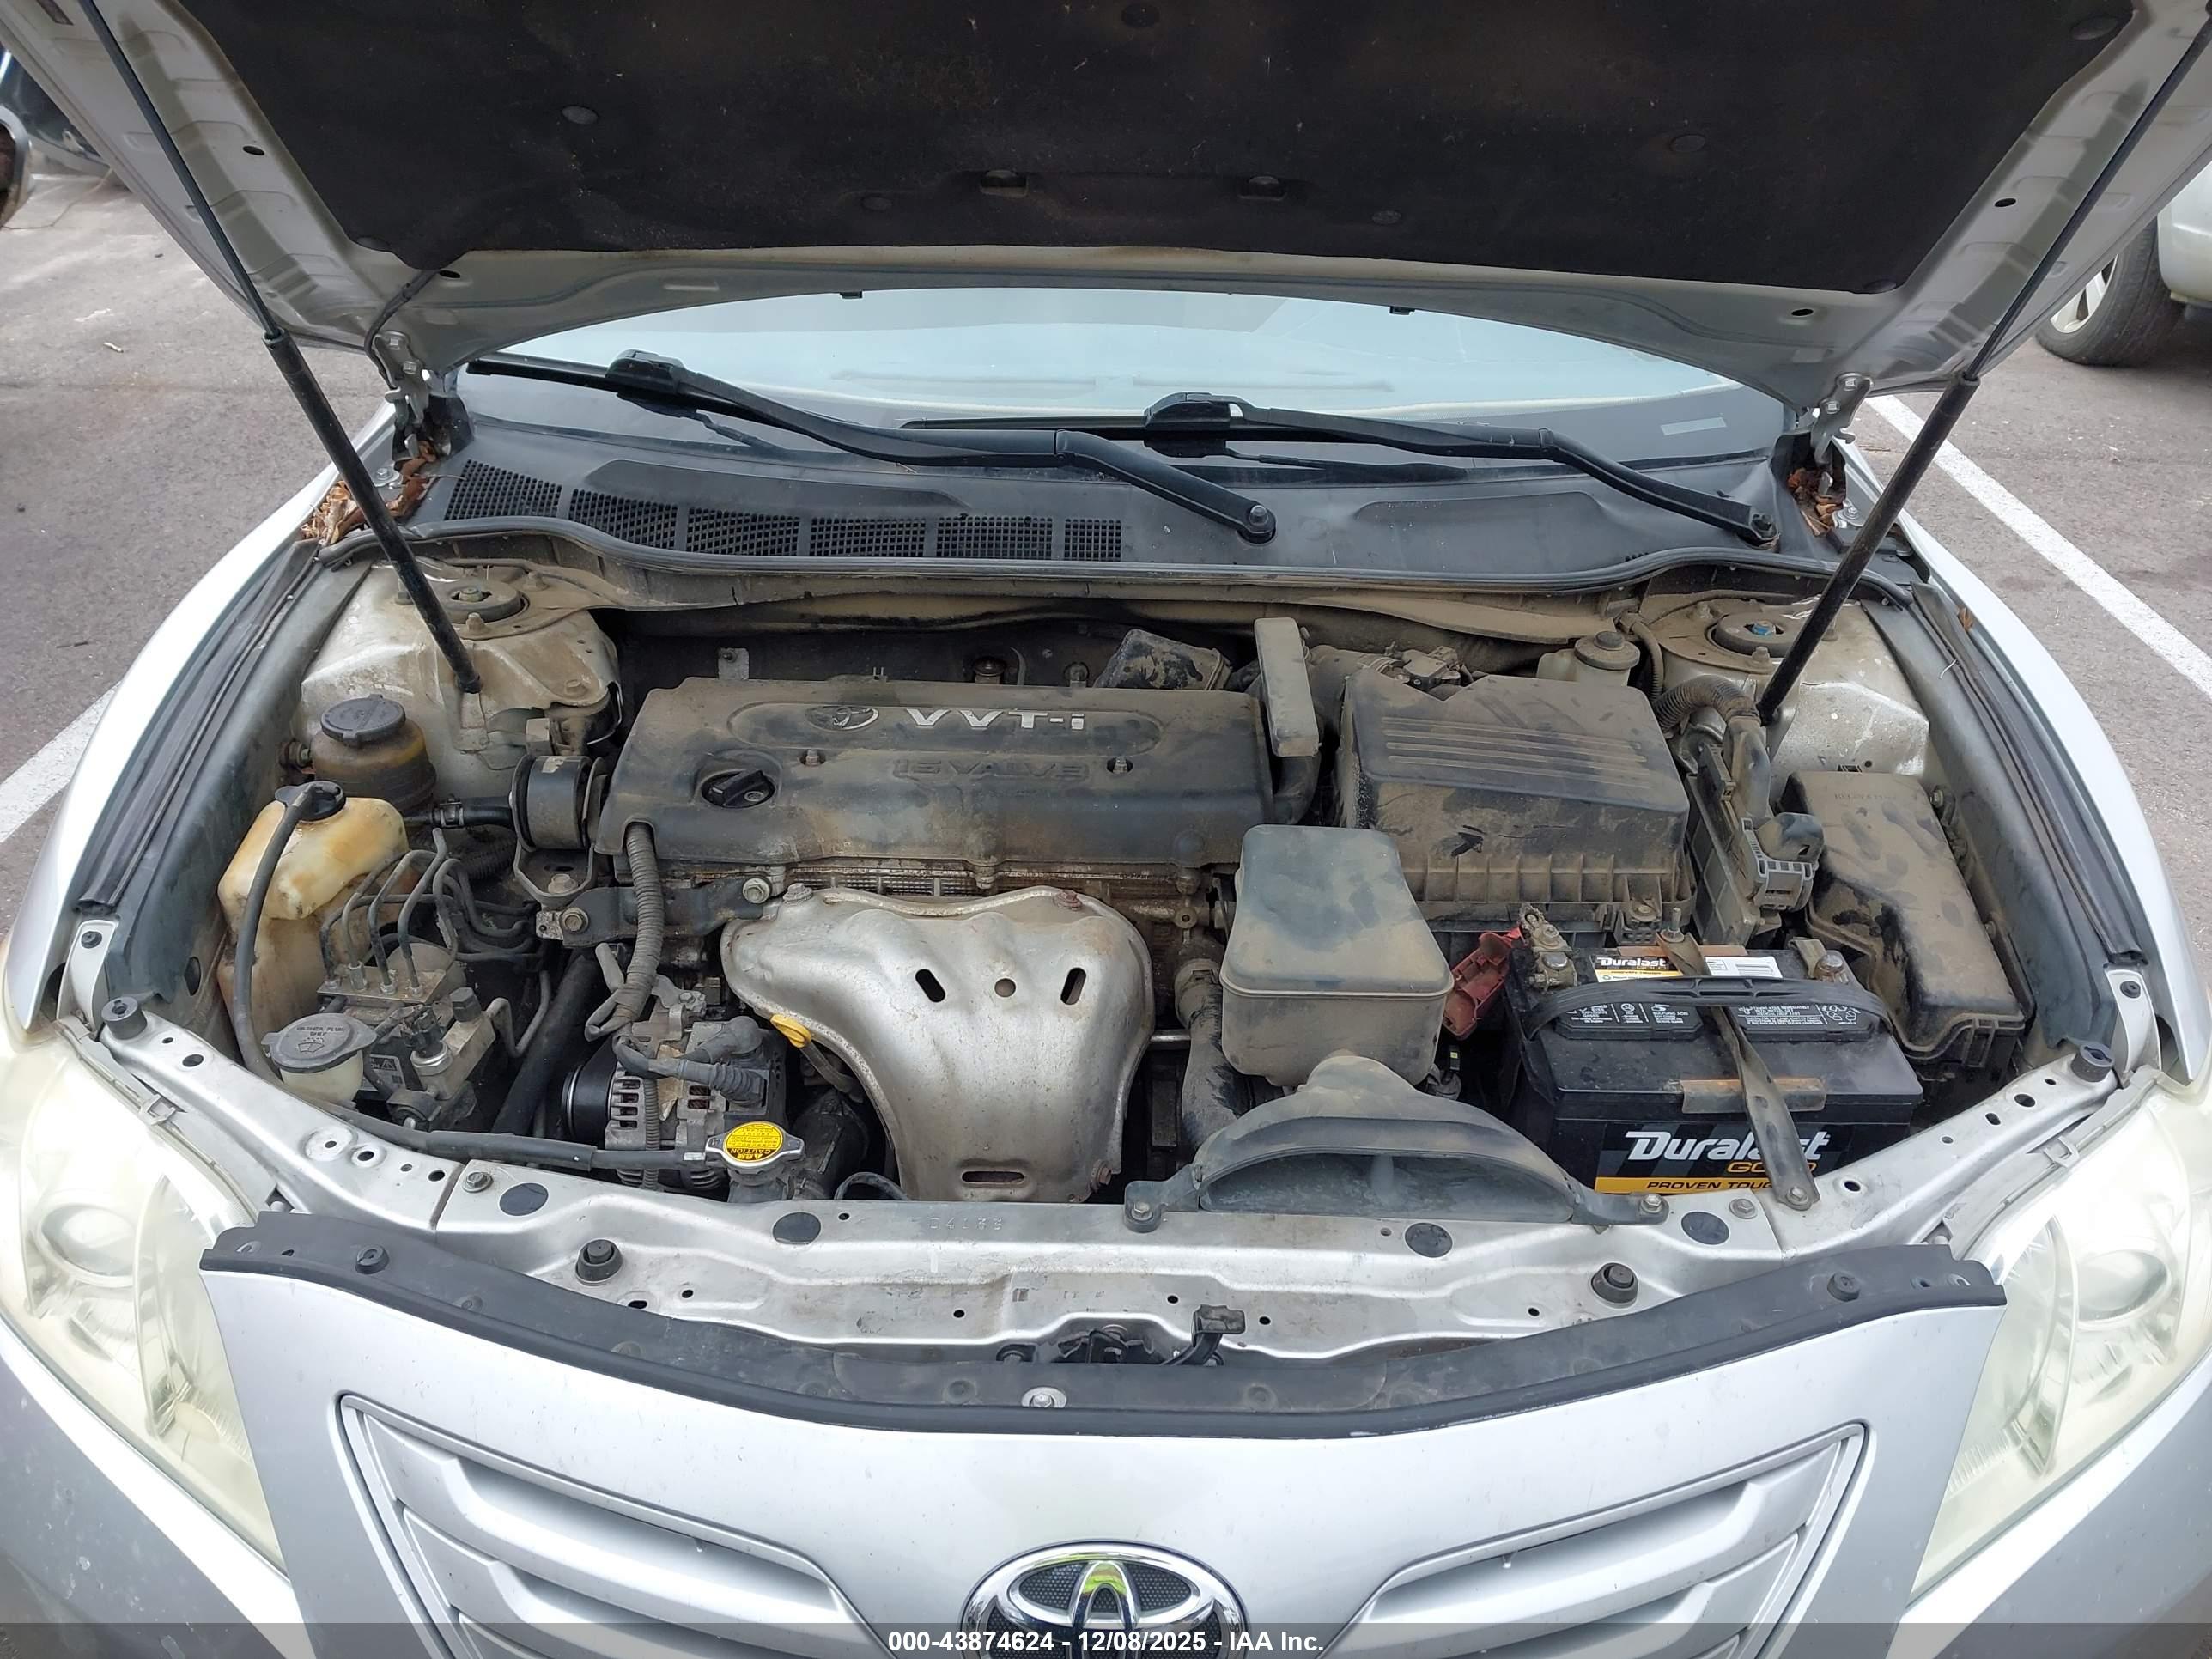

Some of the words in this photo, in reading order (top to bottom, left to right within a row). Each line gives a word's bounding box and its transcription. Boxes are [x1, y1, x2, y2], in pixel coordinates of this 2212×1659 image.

[906, 708, 1085, 731] VVT-i
[1596, 957, 1667, 967] Duralast
[1625, 1131, 1830, 1160] Duralt
